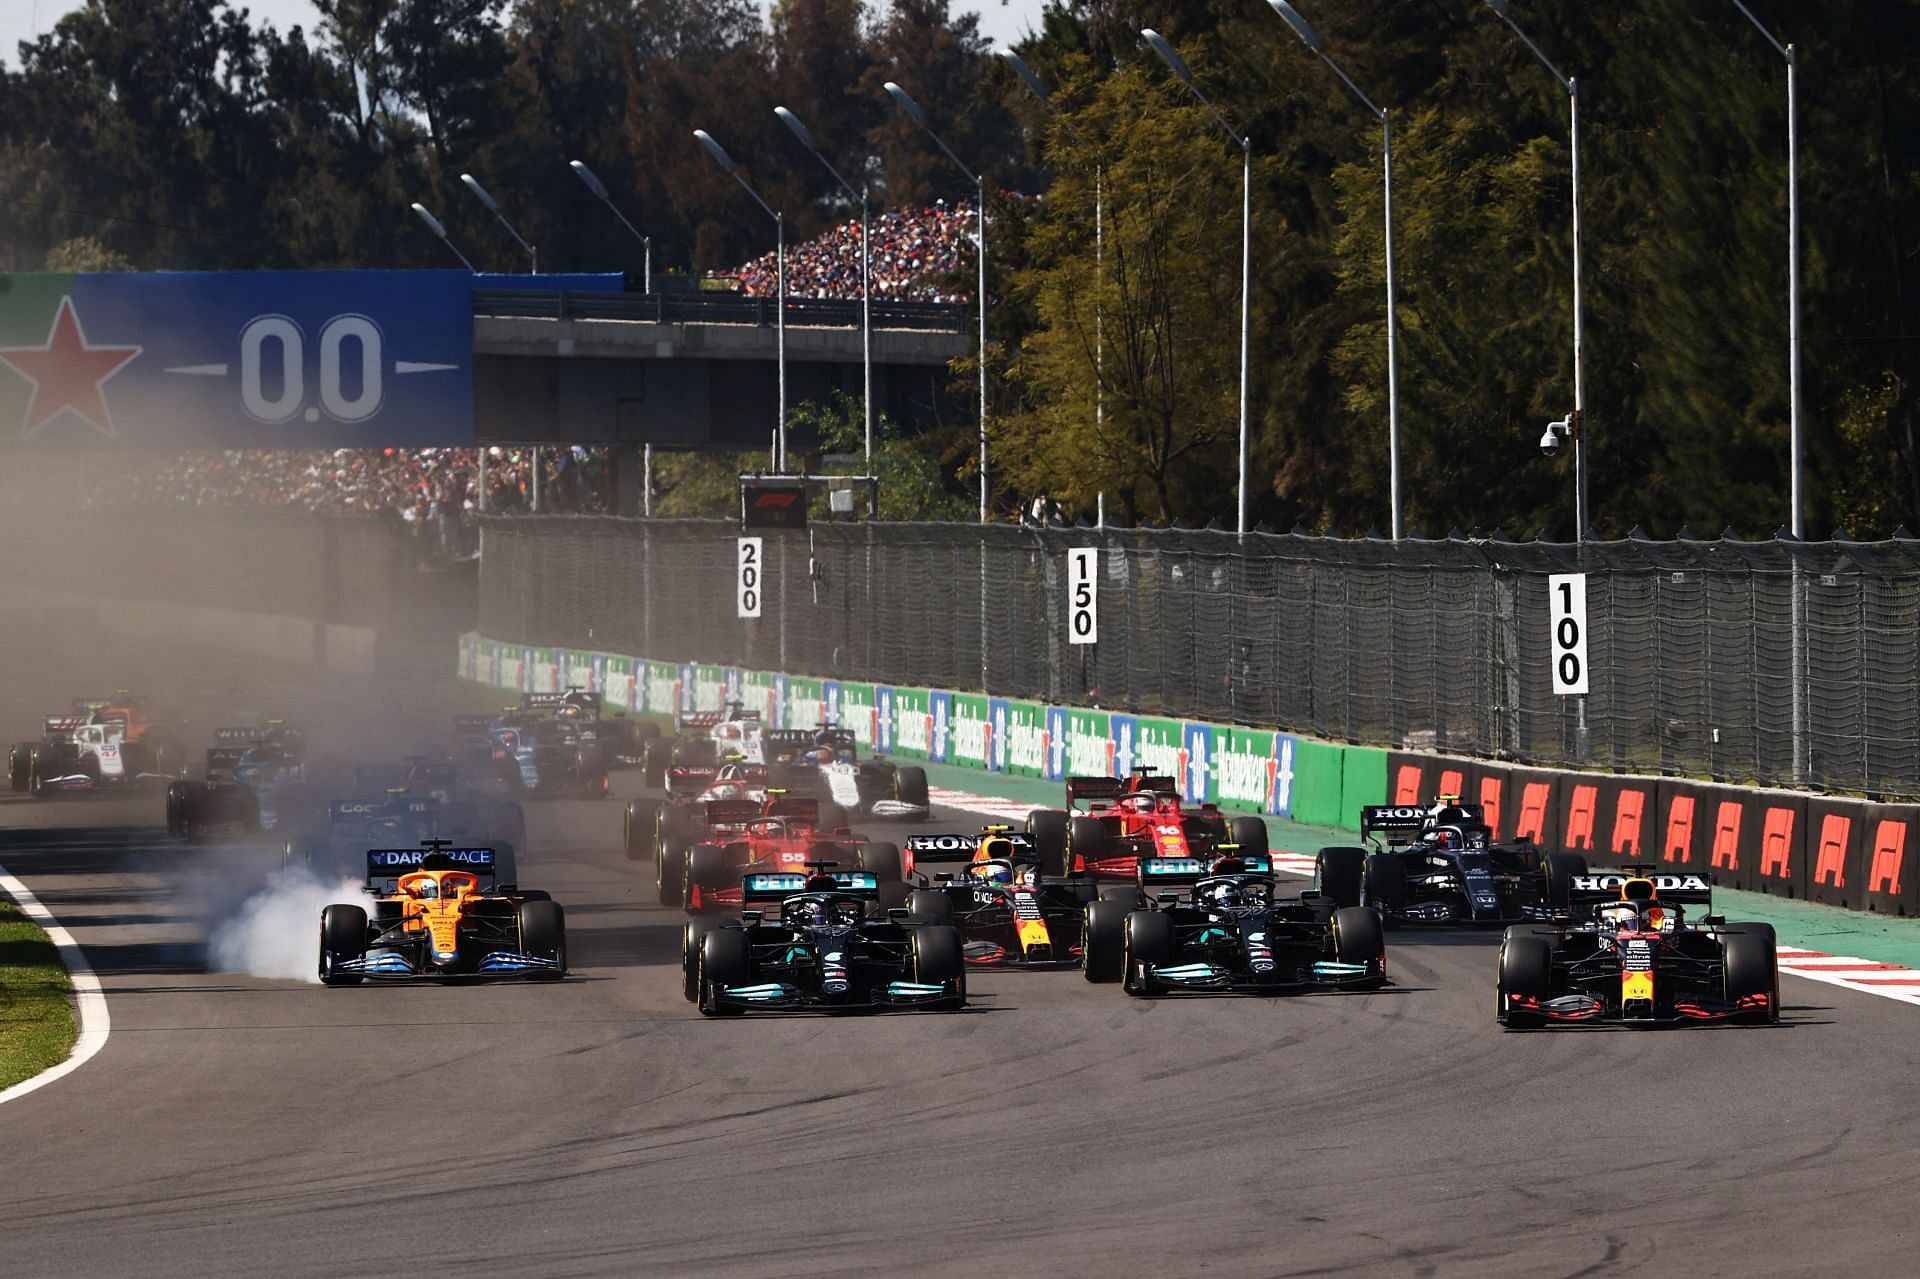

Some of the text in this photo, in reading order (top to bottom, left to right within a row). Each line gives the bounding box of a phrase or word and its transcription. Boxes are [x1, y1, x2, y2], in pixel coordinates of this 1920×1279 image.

[239, 313, 384, 424] 0.0
[742, 543, 756, 611] 200
[1074, 554, 1092, 636] 150
[1557, 582, 1580, 685] 100
[1217, 735, 1267, 804] Heineken
[782, 853, 806, 862] 55
[1156, 825, 1181, 836] 16
[1571, 875, 1710, 891] HODA
